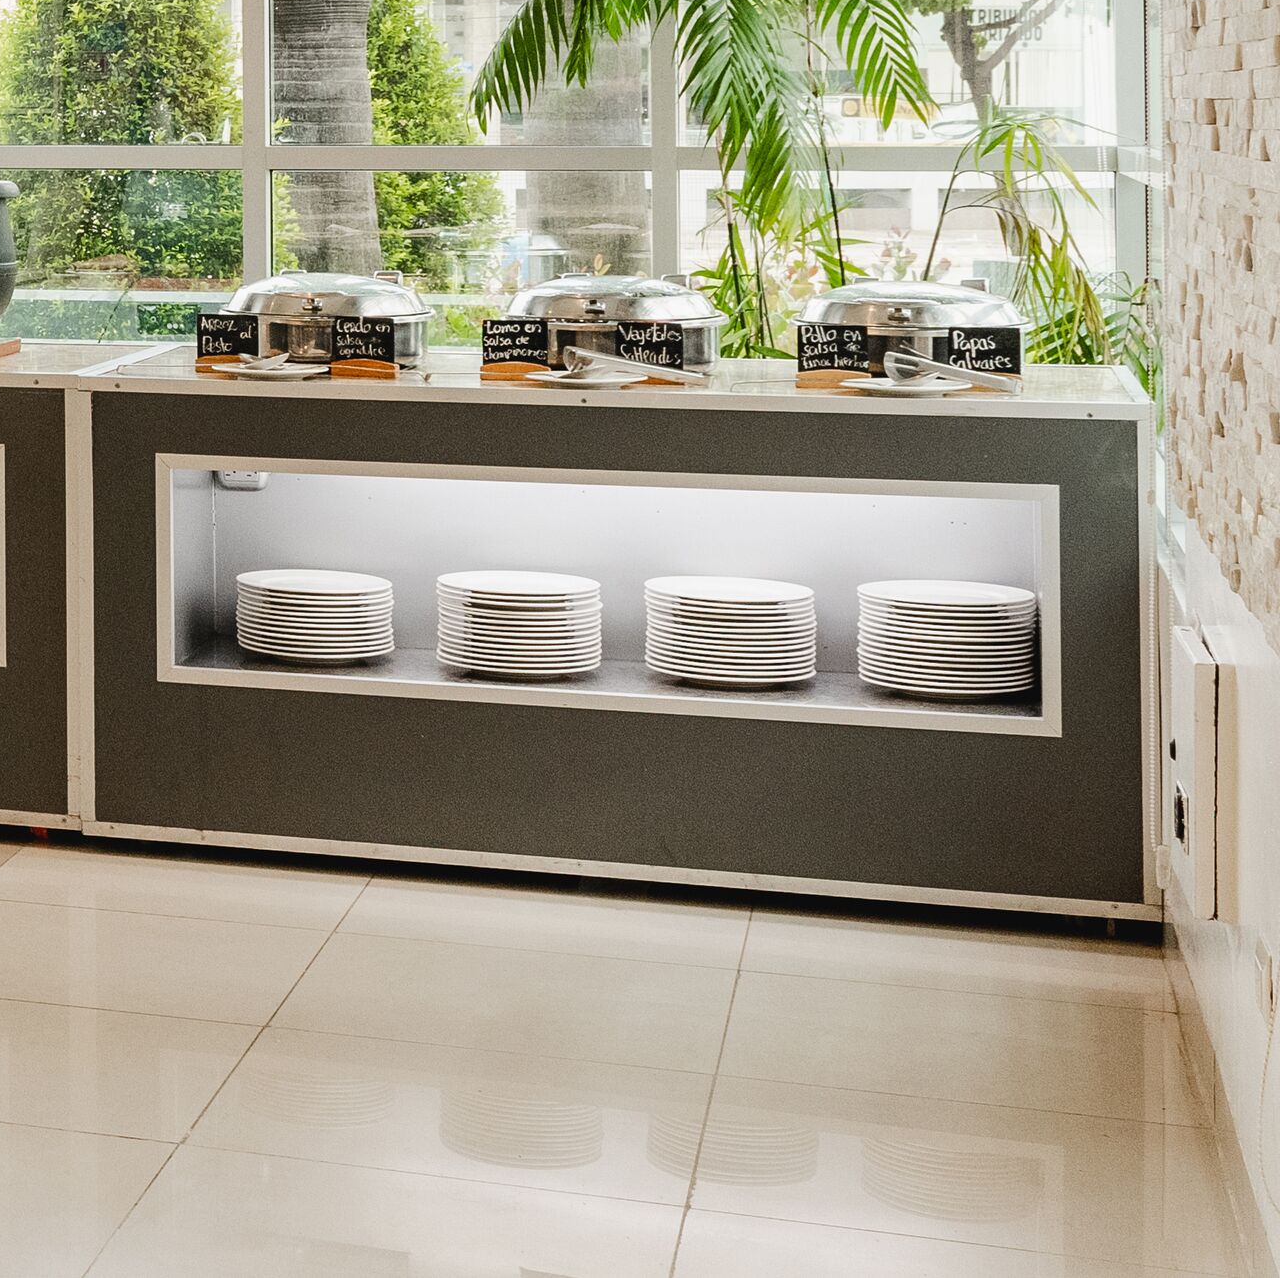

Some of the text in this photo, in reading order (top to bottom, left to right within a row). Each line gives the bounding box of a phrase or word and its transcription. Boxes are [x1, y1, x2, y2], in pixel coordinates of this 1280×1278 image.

[375, 323, 391, 333] en
[485, 320, 542, 334] Lomo en
[515, 335, 530, 345] de
[801, 325, 862, 344] Pollo en
[952, 329, 996, 358] Papas
